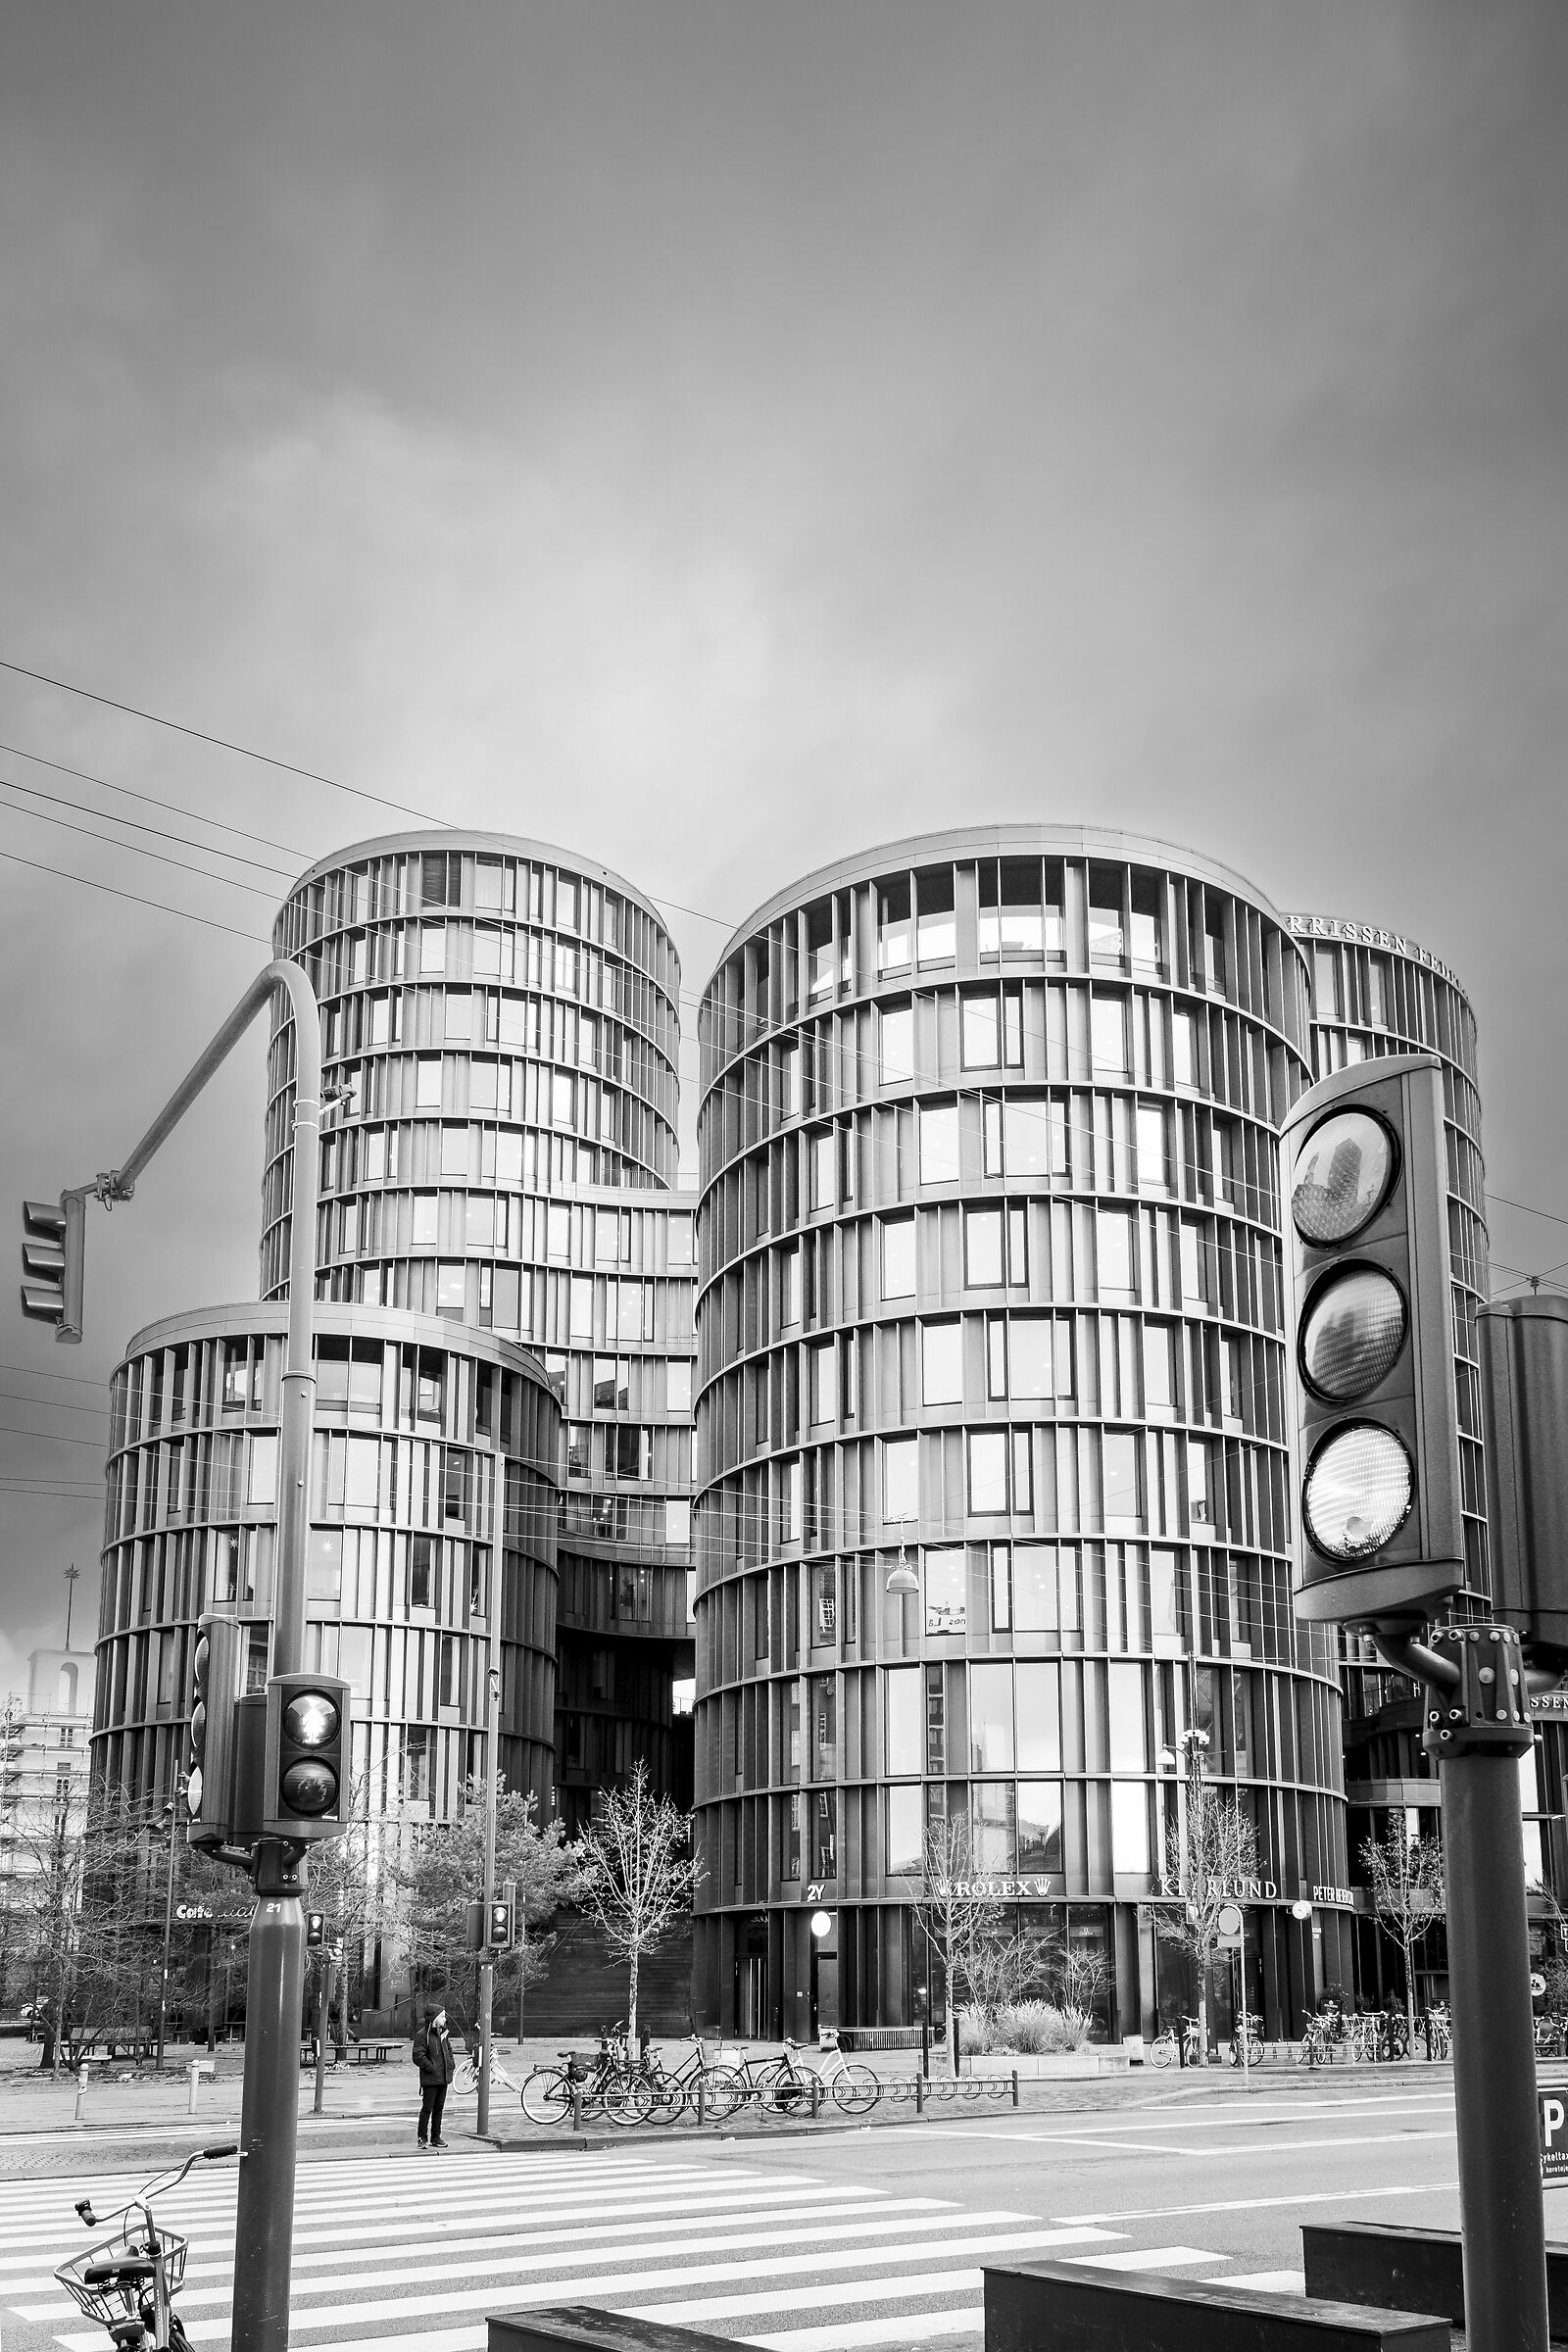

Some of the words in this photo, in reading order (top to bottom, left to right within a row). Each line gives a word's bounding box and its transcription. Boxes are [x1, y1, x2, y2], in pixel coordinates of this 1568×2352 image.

[807, 1884, 825, 1901] 2Y
[955, 1881, 1033, 1896] ROLEX
[1313, 1885, 1336, 1902] PETER
[266, 1902, 281, 1913] 21
[1544, 2099, 1565, 2147] P
